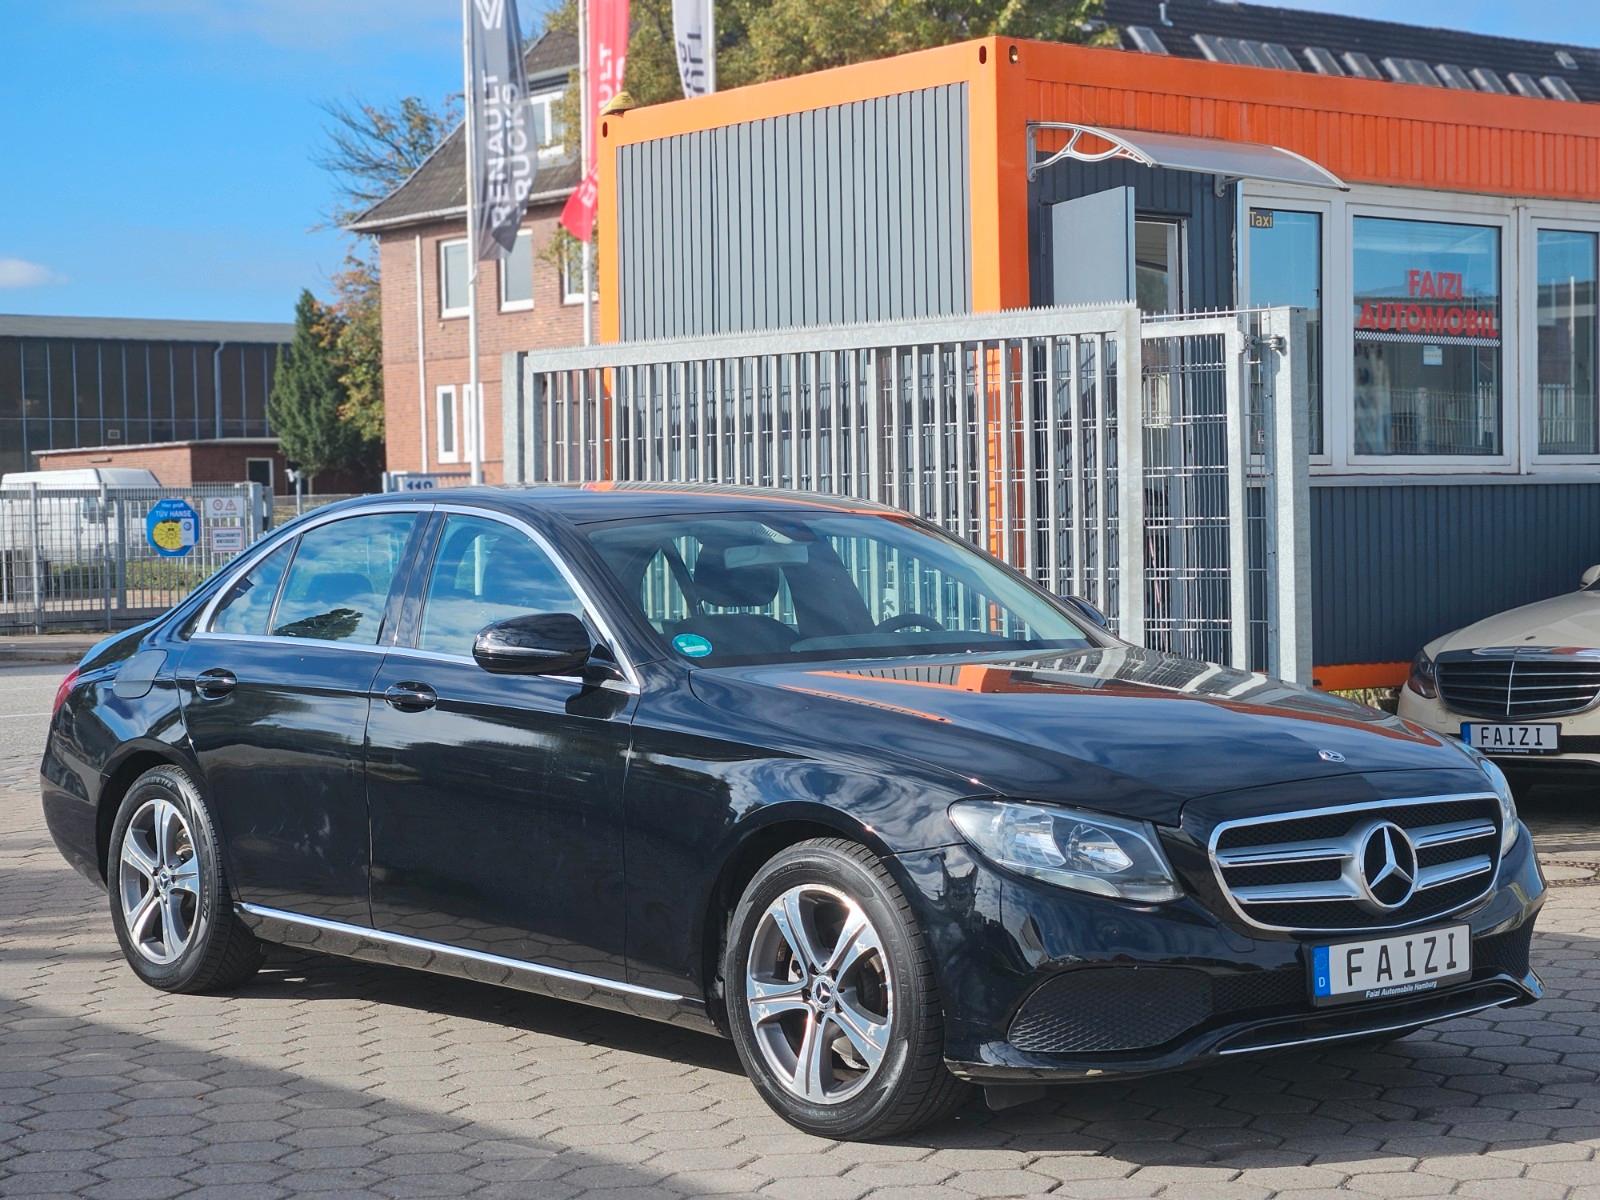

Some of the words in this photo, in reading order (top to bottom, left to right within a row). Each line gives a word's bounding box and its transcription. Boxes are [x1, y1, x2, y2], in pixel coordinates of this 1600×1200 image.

[482, 70, 511, 229] RENAULT
[1248, 211, 1273, 228] Taxi
[1407, 269, 1463, 300] FAIZI
[1359, 302, 1498, 338] AUTOMOBIL
[1480, 727, 1543, 746] FAIZI
[1346, 932, 1457, 986] FAIZI
[1318, 976, 1326, 988] D
[1414, 980, 1438, 992] Hamburg
